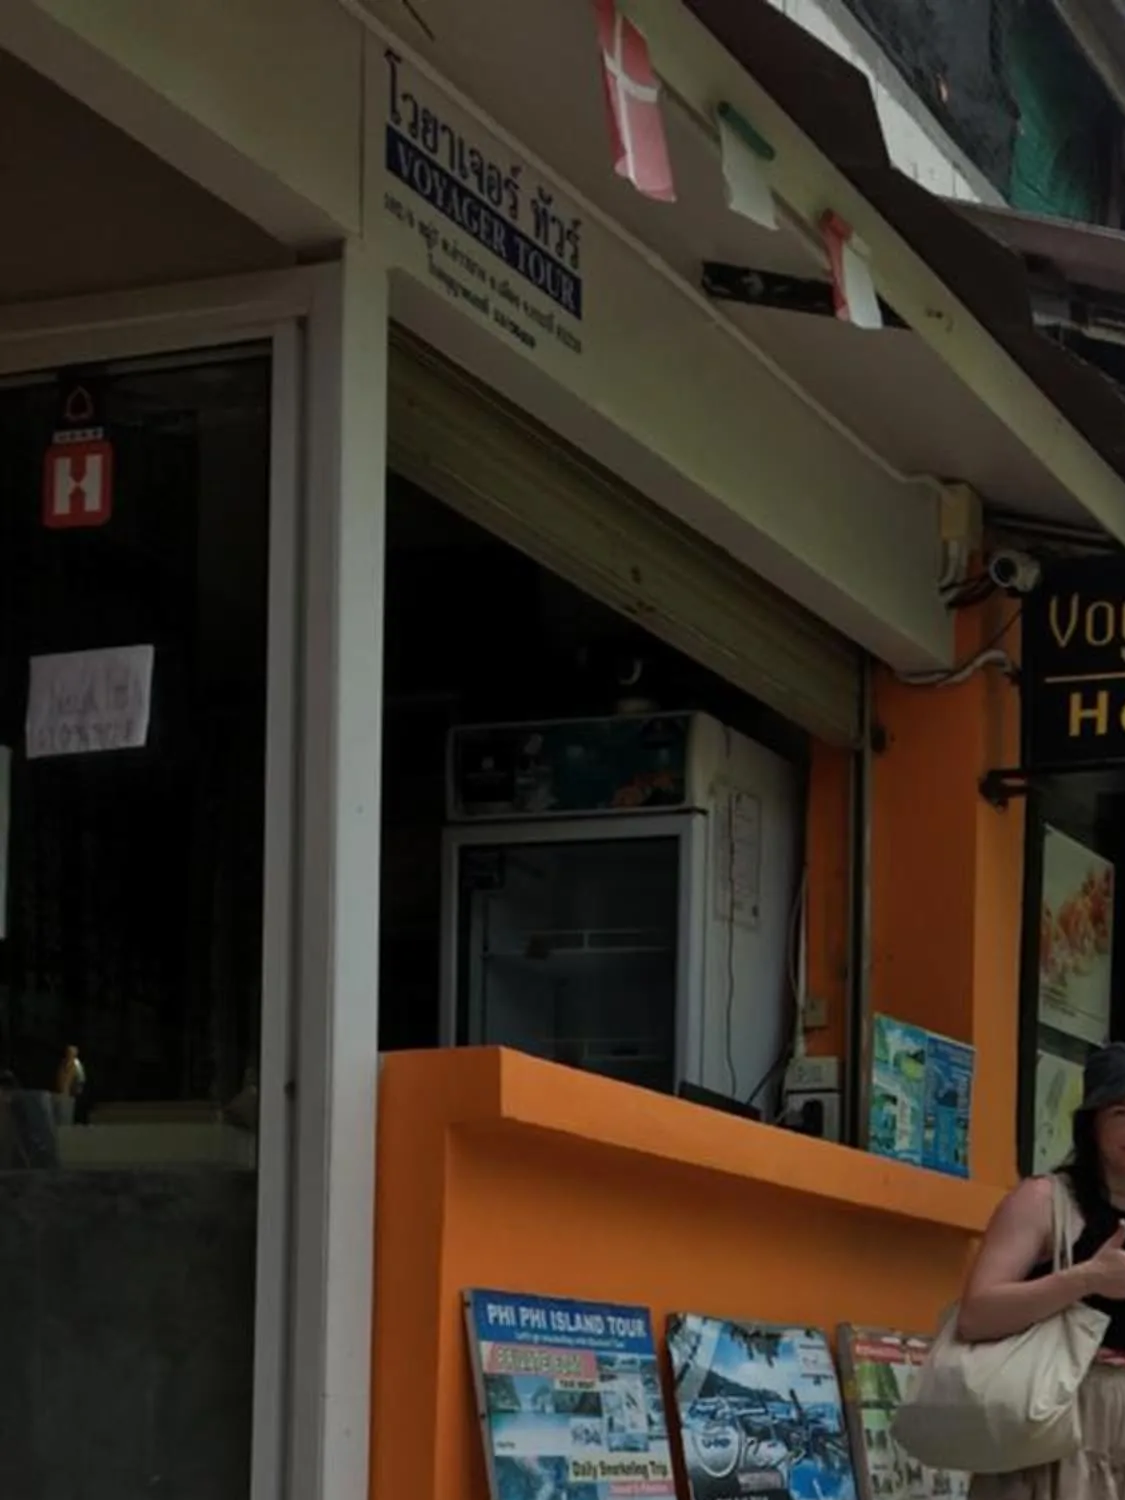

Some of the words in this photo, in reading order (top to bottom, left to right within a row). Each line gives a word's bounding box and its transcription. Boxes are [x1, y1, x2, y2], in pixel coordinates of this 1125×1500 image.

[398, 147, 508, 261] VOYAGER
[514, 234, 577, 313] TOUR
[487, 1303, 516, 1327] PHI
[518, 1306, 547, 1329] PHI
[551, 1309, 605, 1335] ISLAND
[606, 1316, 647, 1338] TOUR
